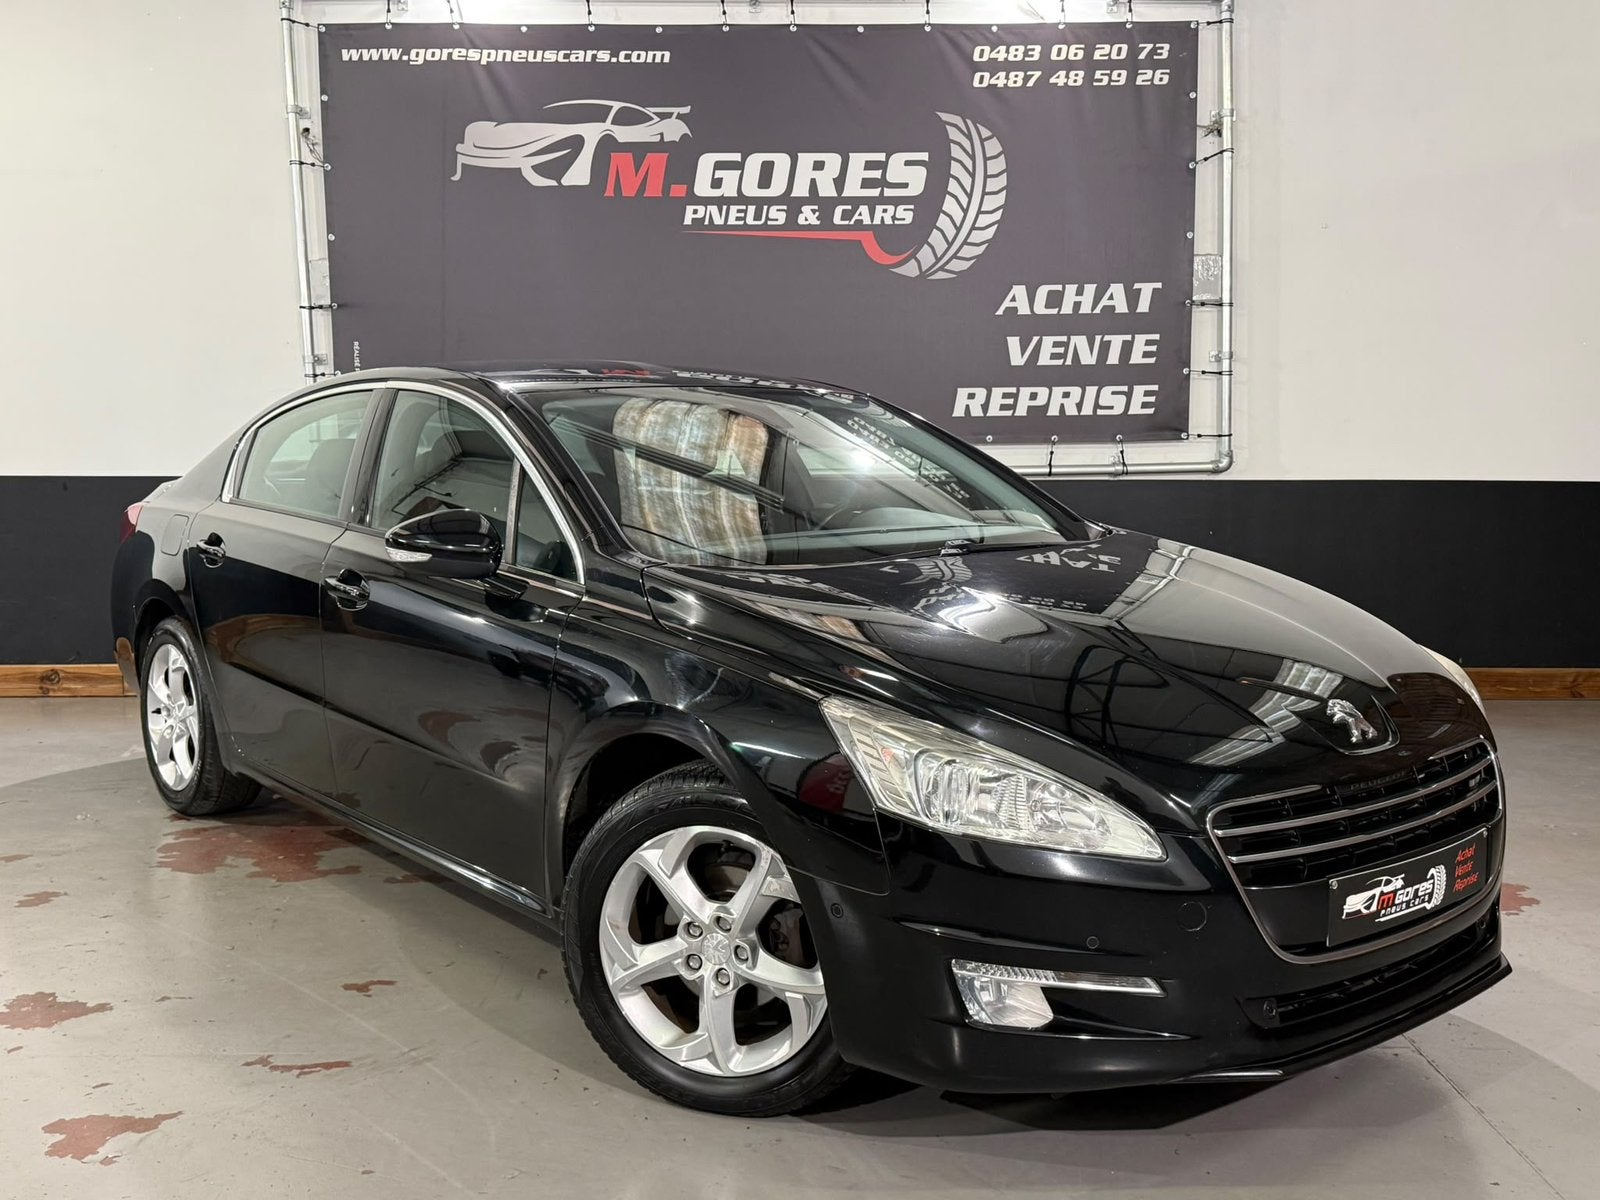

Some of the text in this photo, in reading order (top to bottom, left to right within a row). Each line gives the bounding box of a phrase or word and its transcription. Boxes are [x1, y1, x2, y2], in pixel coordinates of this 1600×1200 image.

[341, 47, 670, 65] www.gorespneuscars.com
[972, 43, 1170, 62] 0483 06 20 73
[972, 69, 1170, 88] 0487 48 59 26
[683, 204, 915, 226] PNEUS & CARS
[995, 281, 1163, 316] ACHAT
[1006, 333, 1160, 366] VENTE
[951, 384, 1159, 418] REPRISE
